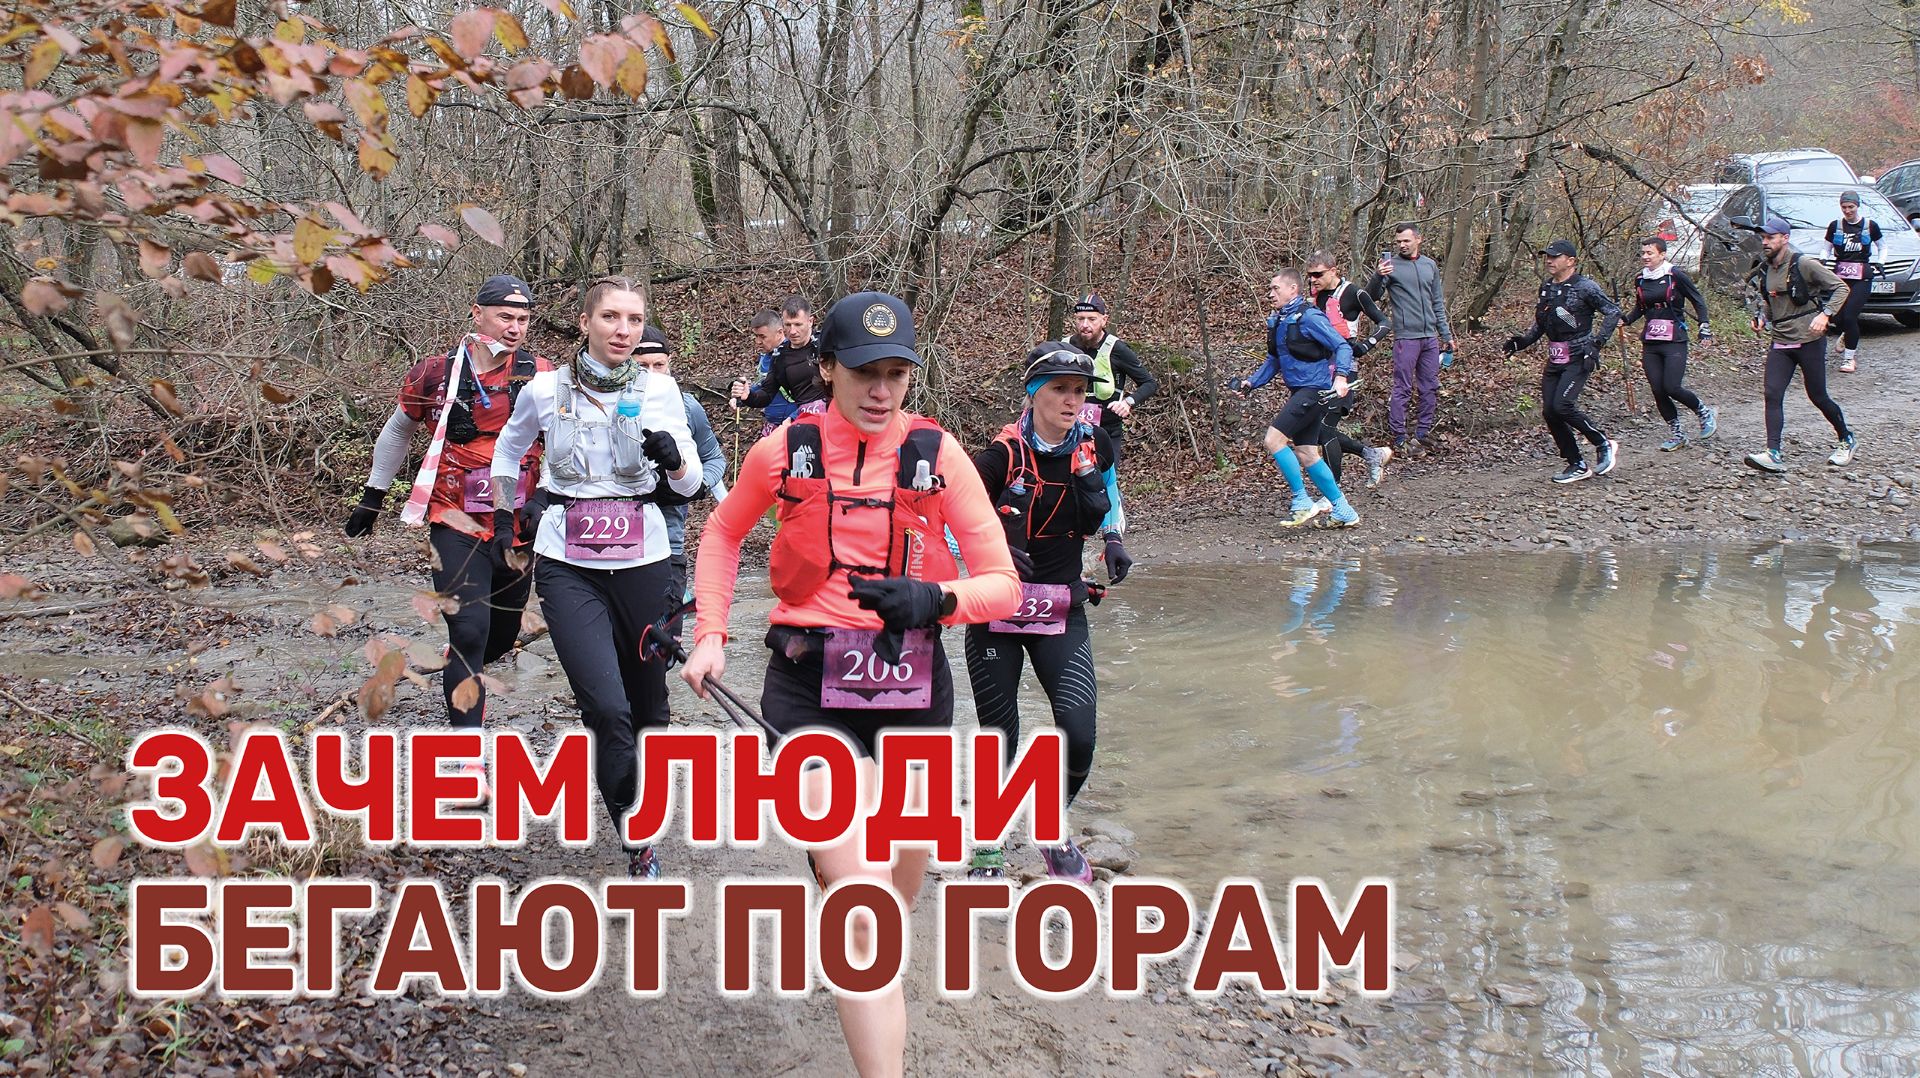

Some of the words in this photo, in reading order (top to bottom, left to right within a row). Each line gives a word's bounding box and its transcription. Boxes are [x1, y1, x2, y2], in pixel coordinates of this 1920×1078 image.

[1841, 265, 1858, 274] 268
[1879, 282, 1894, 290] 123
[1649, 324, 1667, 334] 259
[1550, 347, 1564, 357] 02
[579, 516, 630, 539] 229
[841, 650, 914, 683] 206
